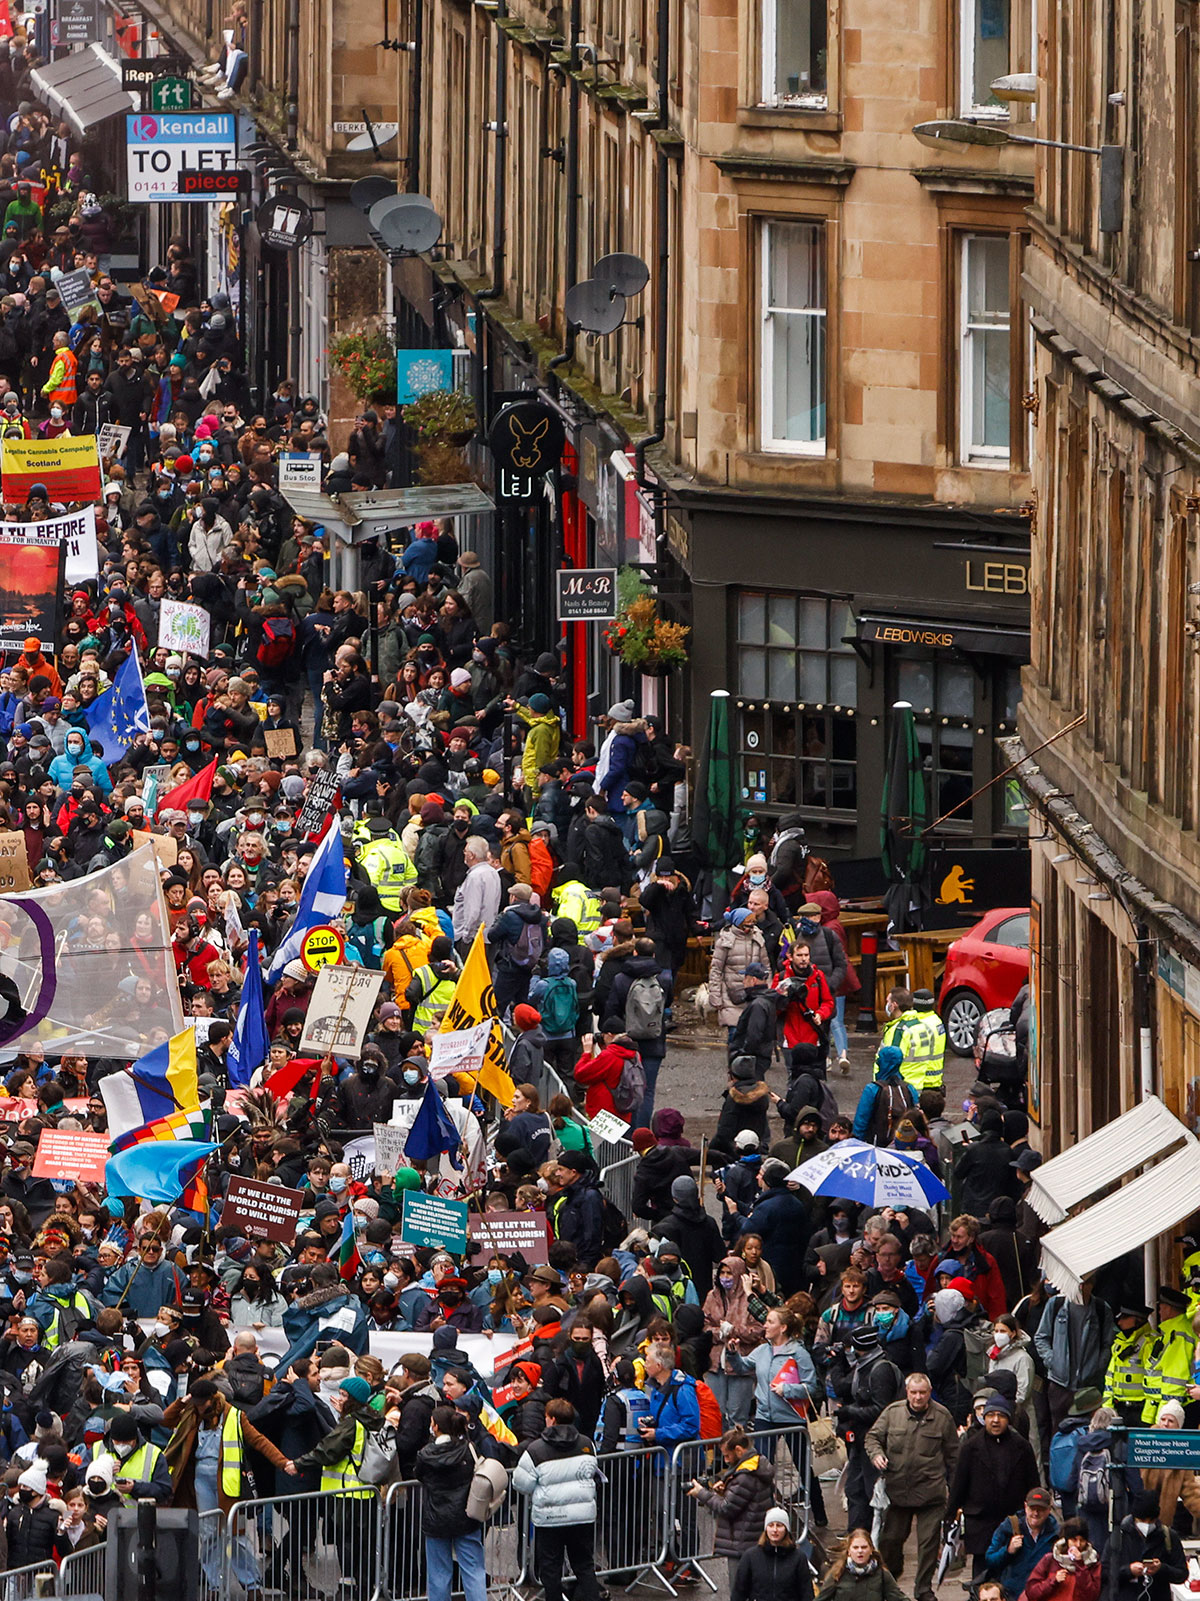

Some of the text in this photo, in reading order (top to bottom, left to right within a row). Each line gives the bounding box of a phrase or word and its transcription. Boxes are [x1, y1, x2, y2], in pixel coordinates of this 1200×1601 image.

[160, 116, 228, 135] kendall
[132, 150, 232, 173] TO LET
[134, 181, 168, 192] 0141
[184, 173, 239, 192] piece
[4, 443, 95, 456] Legalise Cannabis Campaign
[26, 459, 61, 467] Scotland
[299, 473, 316, 482] Stop
[37, 517, 85, 537] BEFORE
[26, 537, 60, 546] HUMANITY
[563, 576, 584, 595] M
[594, 576, 611, 594] R
[564, 599, 610, 608] Nails Beauty
[164, 633, 177, 645] NO
[875, 627, 954, 647] LEBOWSKIS
[272, 739, 288, 747] NOT
[316, 769, 342, 786] POLICE
[309, 935, 335, 947] STOP
[238, 1186, 292, 1206] IF WE LET THE
[228, 1194, 299, 1217] WORLD FLOURISH
[236, 1207, 285, 1225] SO WILL WE!
[490, 1221, 536, 1230] WE LET THE
[505, 1230, 545, 1239] FLOURISH
[497, 1240, 535, 1249] WILL WE!
[1134, 1439, 1190, 1448] Moat House Hotel
[1134, 1447, 1183, 1457] Glasgow Science
[1134, 1455, 1152, 1463] WEST
